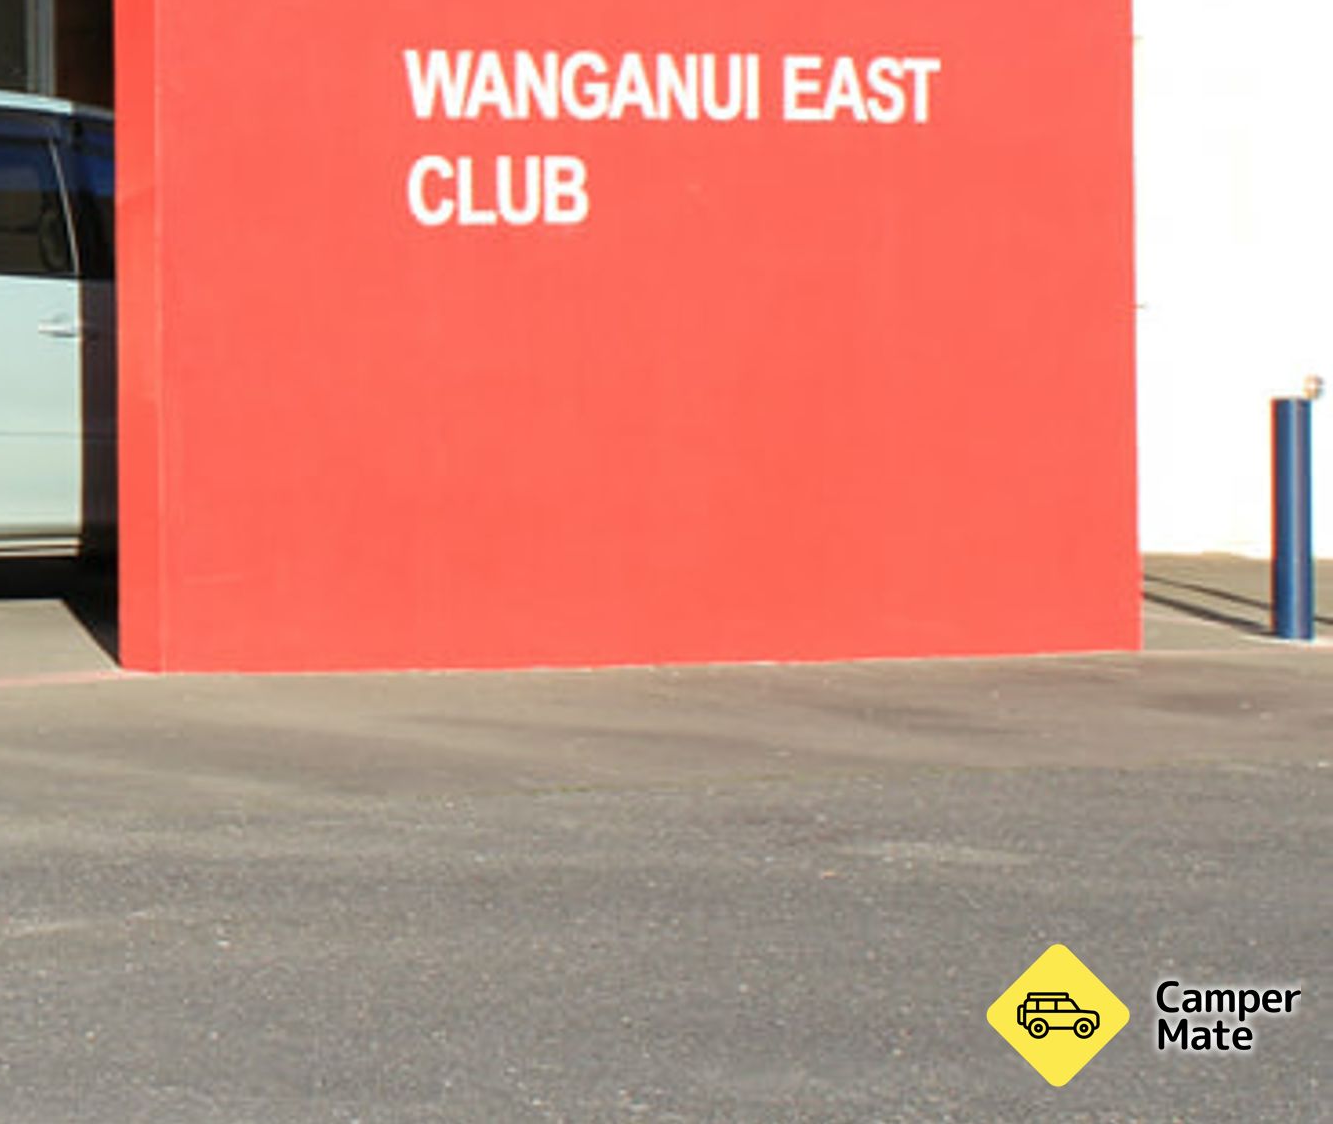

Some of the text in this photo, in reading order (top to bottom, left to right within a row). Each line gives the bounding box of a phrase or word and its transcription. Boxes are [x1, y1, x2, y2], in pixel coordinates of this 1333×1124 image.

[403, 49, 941, 123] WANGANUI EAST
[407, 155, 589, 226] CLUB
